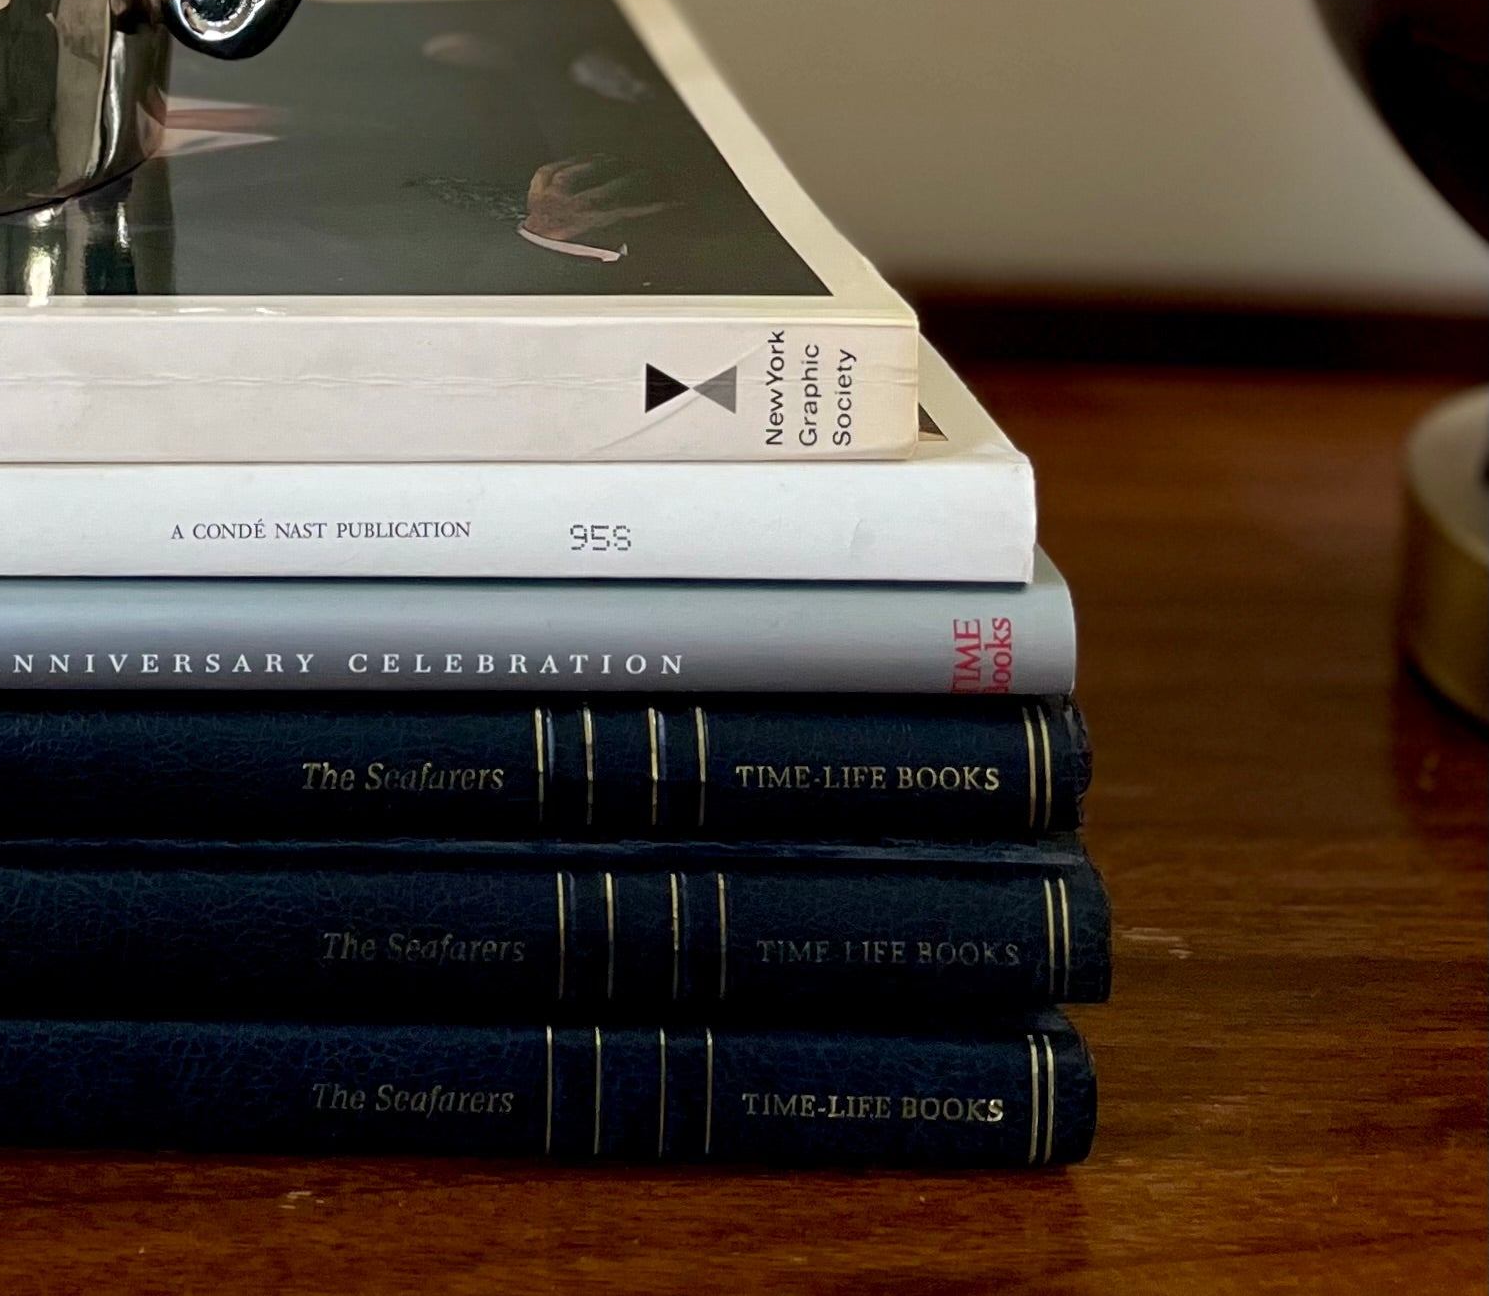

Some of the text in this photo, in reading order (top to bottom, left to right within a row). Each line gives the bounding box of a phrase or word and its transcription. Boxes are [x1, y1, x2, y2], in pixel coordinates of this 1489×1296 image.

[798, 343, 822, 447] Graphic
[832, 349, 857, 447] Society
[171, 518, 471, 540] A CONDÉ NAST PUBLICATION
[348, 652, 684, 675] CELEBRATION
[302, 762, 504, 792] The Seafarers
[735, 765, 1000, 791] TIME-LIFE BOOKS
[323, 932, 525, 966] The Seafarers
[757, 939, 1022, 966] TIMELIFE BOOKS
[312, 1082, 513, 1119] The Seafarers
[742, 1093, 1005, 1123] TIME-LIFE BOOKS
